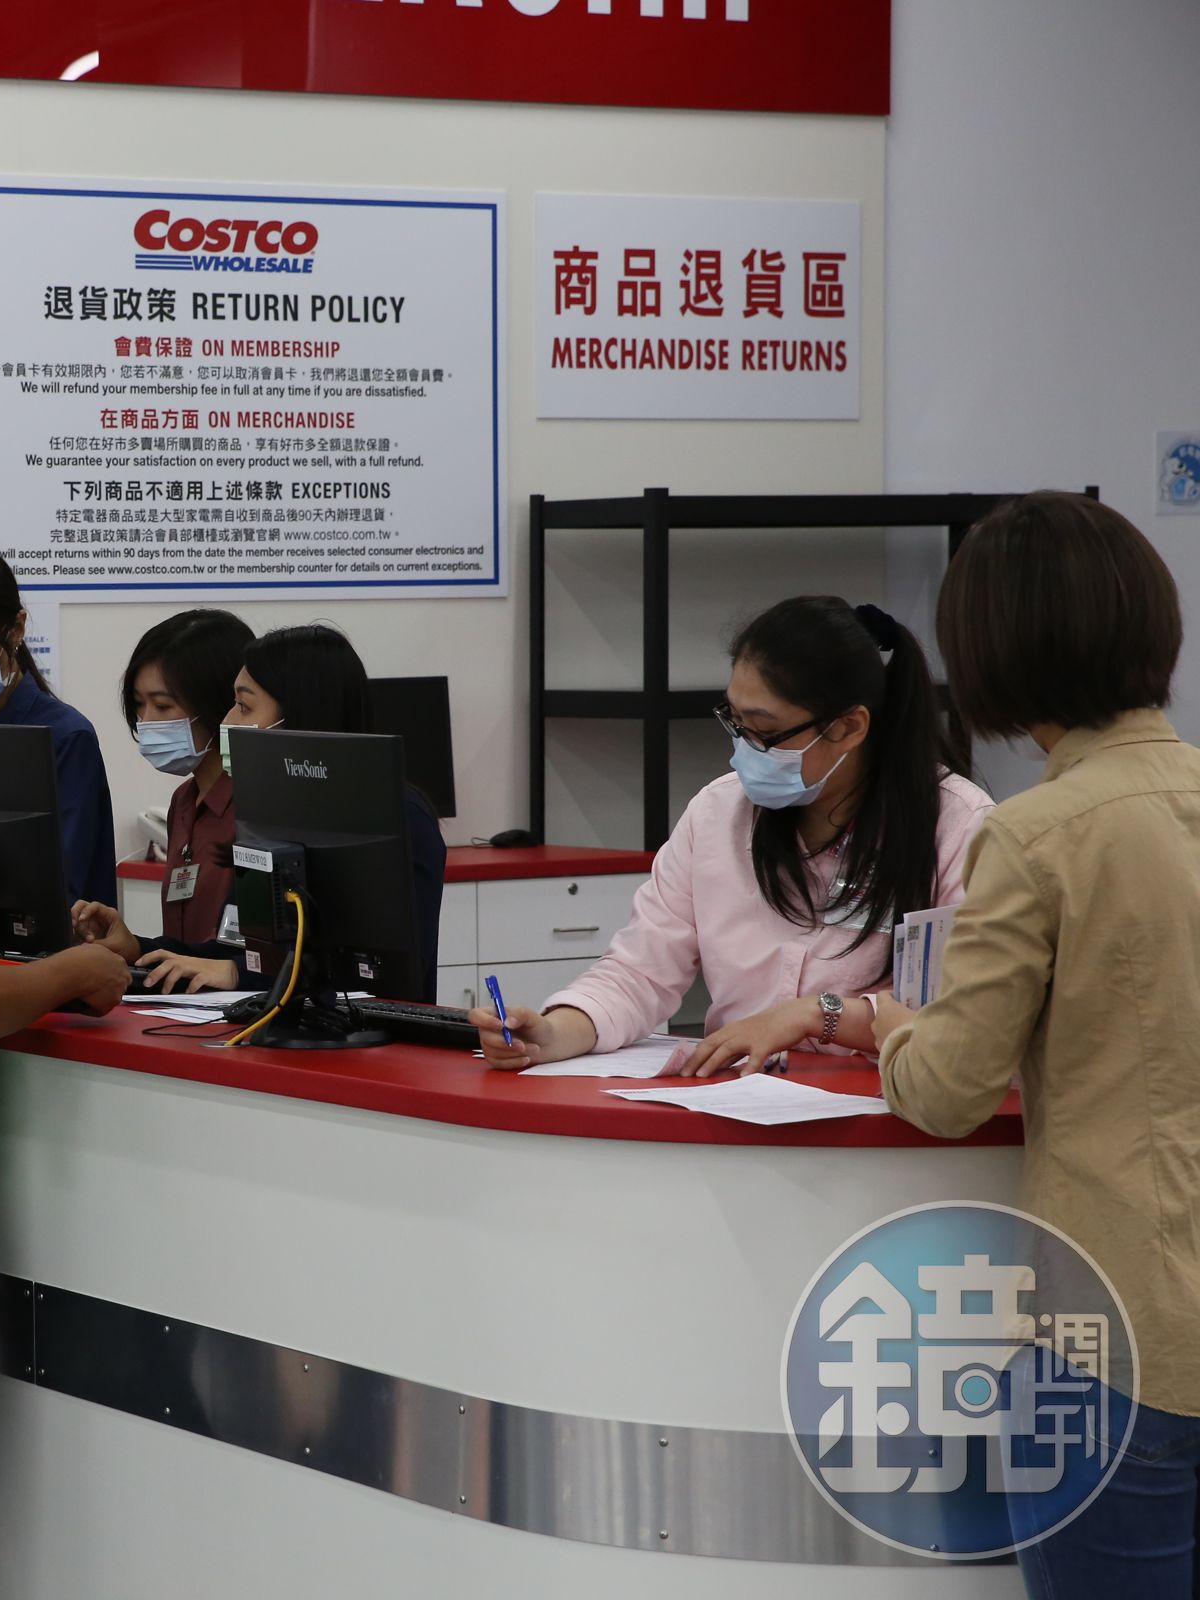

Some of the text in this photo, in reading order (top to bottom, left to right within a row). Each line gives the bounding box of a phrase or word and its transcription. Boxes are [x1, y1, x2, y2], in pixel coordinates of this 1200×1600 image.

[133, 209, 319, 255] COSTCO
[191, 255, 314, 274] WHOLESALE
[553, 245, 847, 319] 商品退貨區
[44, 285, 405, 324] 退貨政策 RETURN POLICY
[114, 336, 340, 358] 會費保證 ON MEMBERSHIP
[551, 338, 848, 372] MERCHANDISE RETURNS
[20, 381, 427, 399] We will refund your membership fee in full at any time if you are dissatisfied.
[100, 409, 355, 430] 在商品方面 ON MERCHANDISE
[25, 454, 424, 469] We guarantee your satisfaction on every product we sell, with a full refund.
[63, 481, 391, 501] 下列商品不適用上述條款 EXCEPTIONS
[284, 758, 328, 779] ViewSonic
